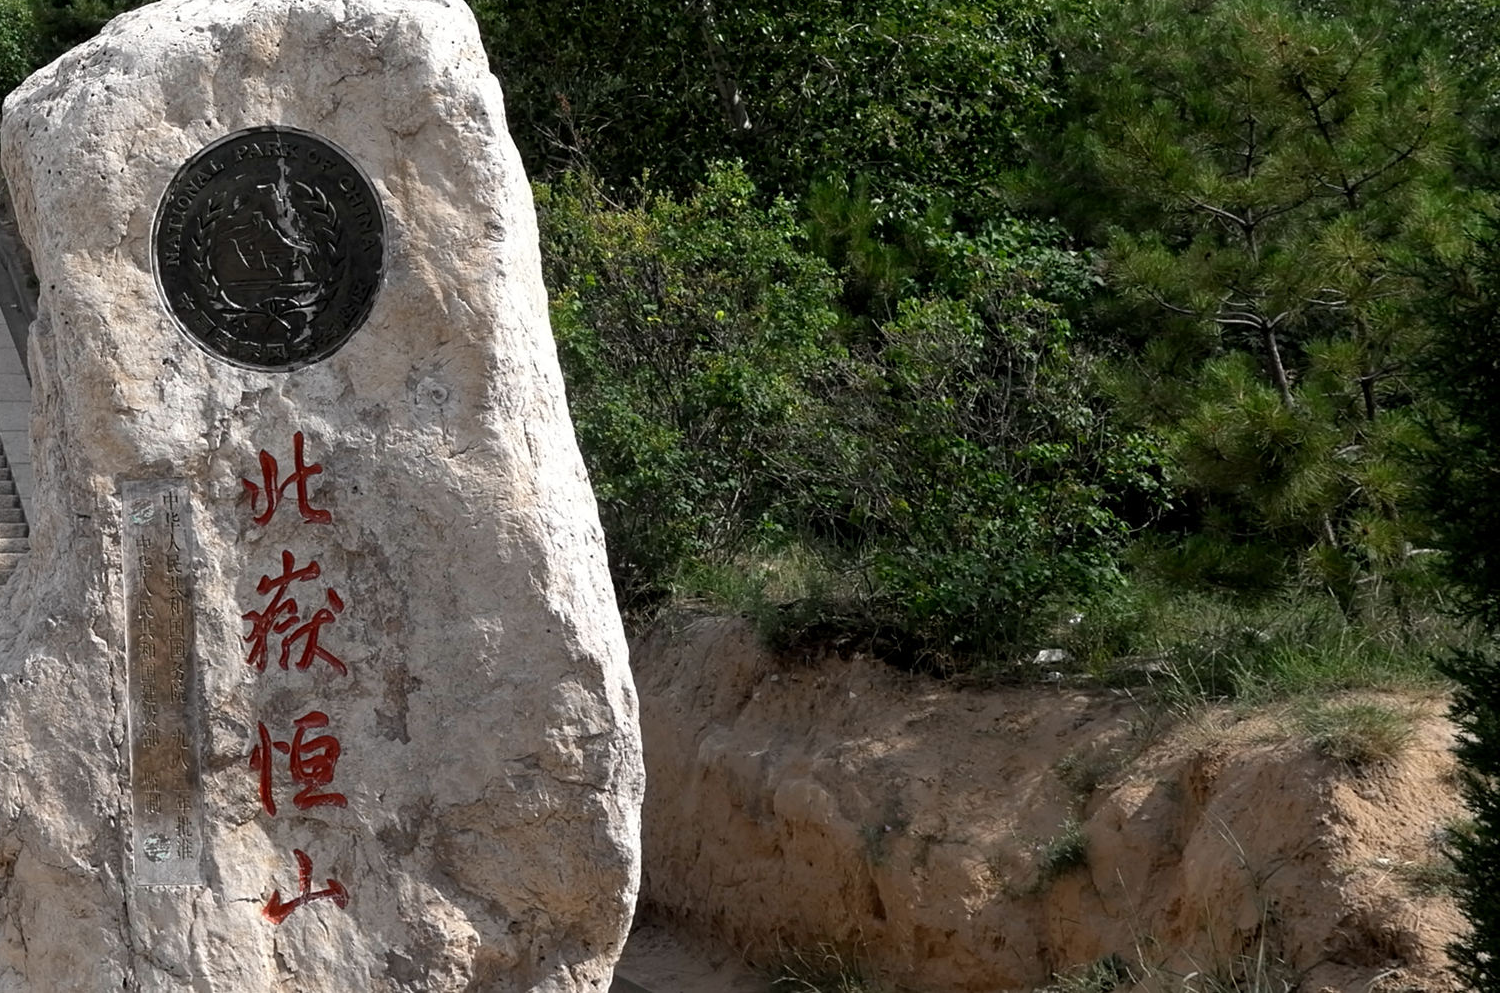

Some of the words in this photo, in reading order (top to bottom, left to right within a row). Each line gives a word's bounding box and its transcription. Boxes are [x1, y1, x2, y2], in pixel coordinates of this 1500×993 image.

[165, 158, 226, 267] NATIONAL
[234, 140, 299, 162] PARK
[306, 149, 337, 171] OF
[338, 175, 377, 253] CHINA
